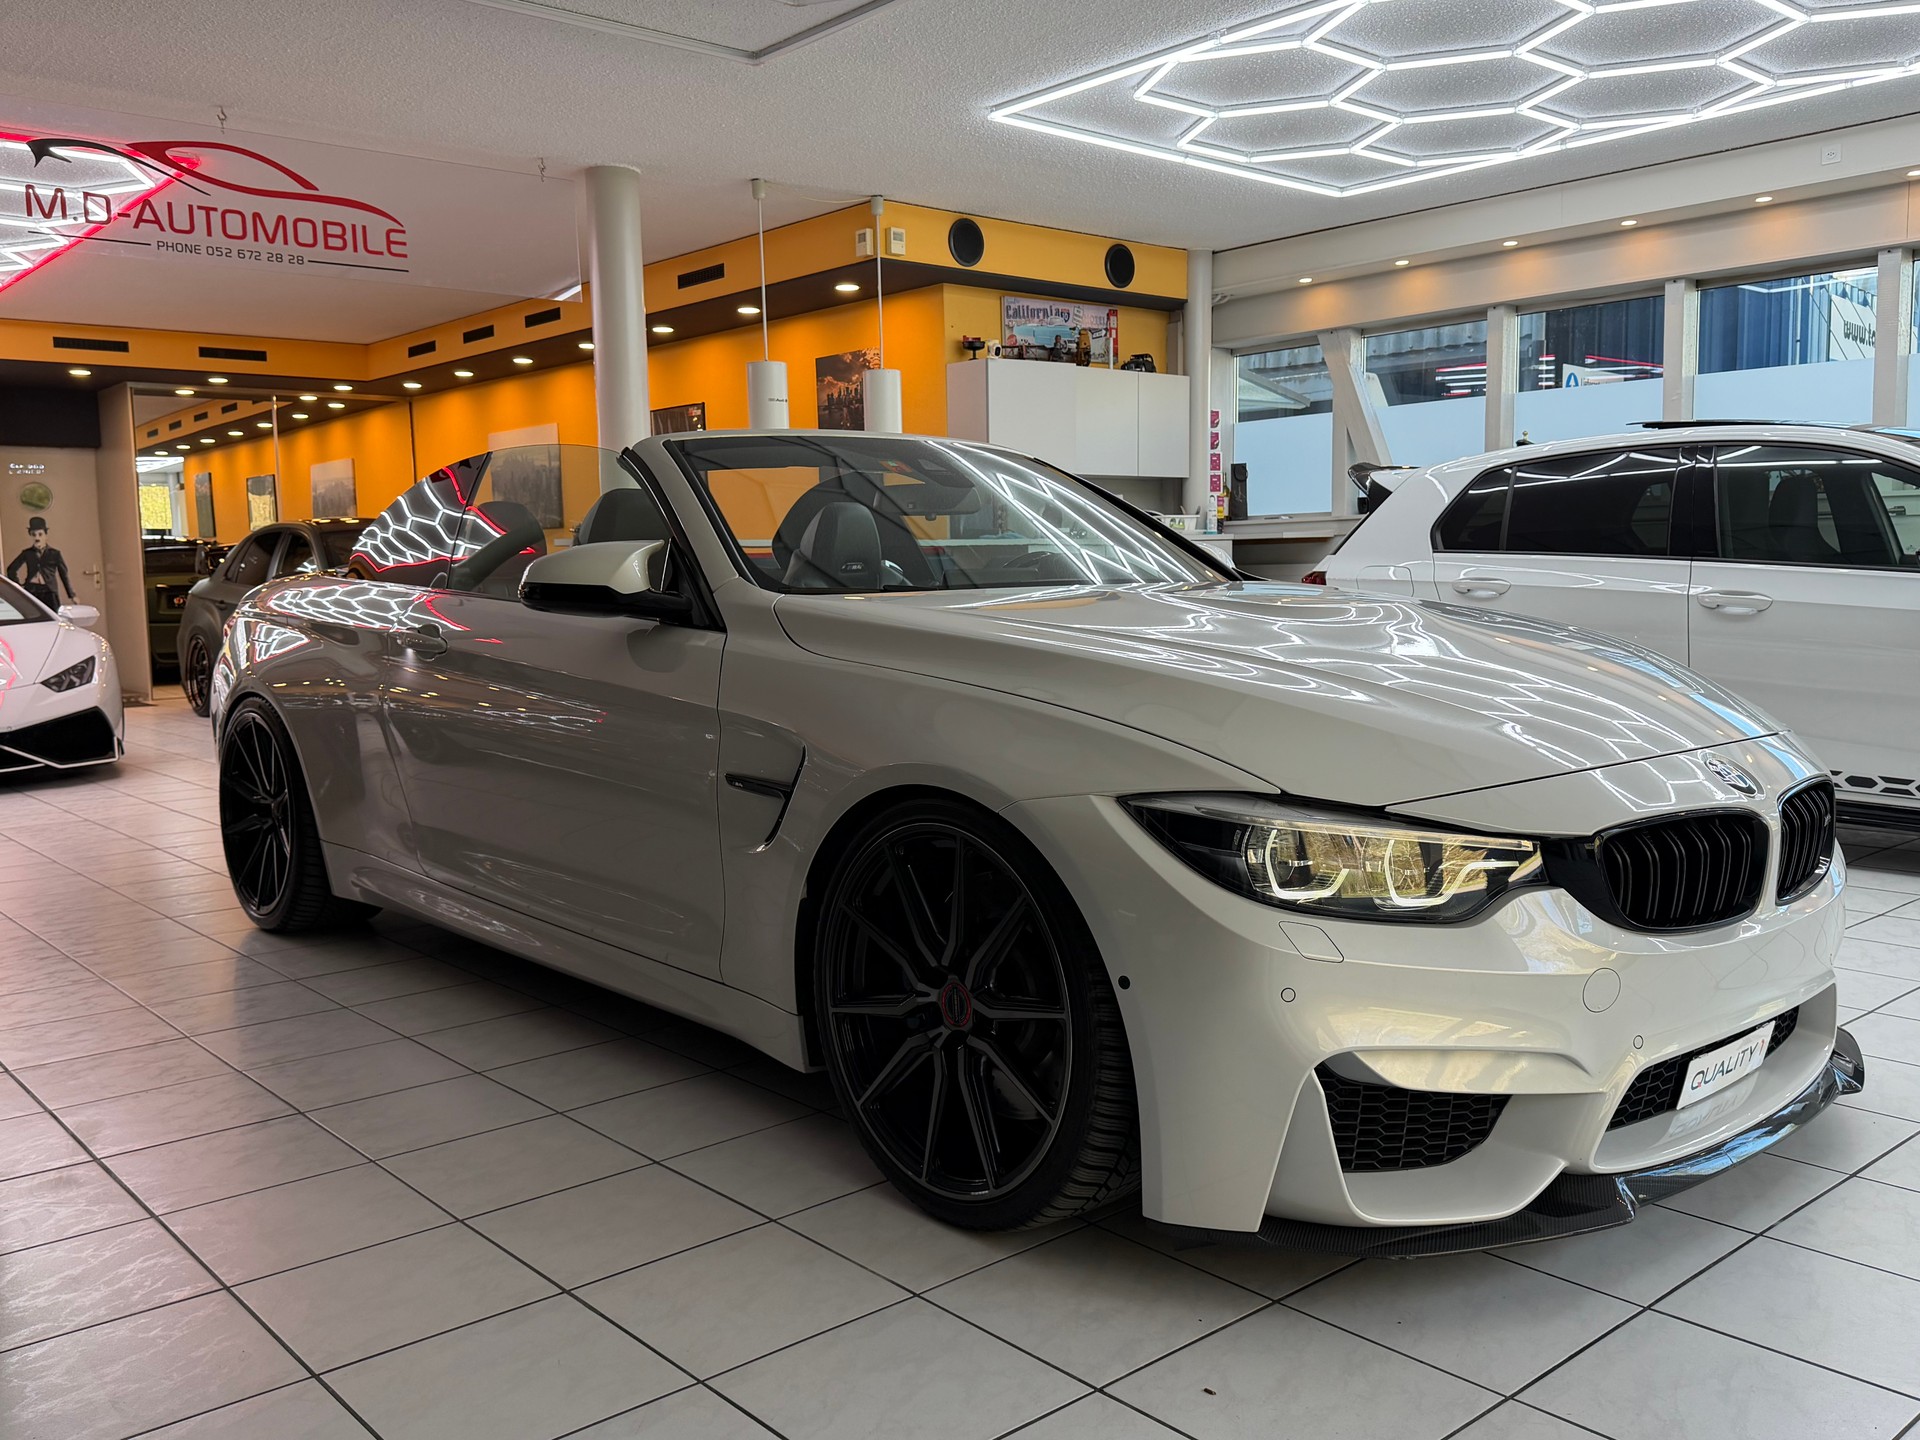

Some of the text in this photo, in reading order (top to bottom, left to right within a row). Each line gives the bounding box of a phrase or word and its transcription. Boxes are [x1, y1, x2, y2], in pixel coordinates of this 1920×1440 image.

[25, 184, 408, 259] M.D-AUTOMOBILE
[156, 240, 305, 266] PHONE 052 672 28 28
[1005, 304, 1060, 319] California
[1690, 1041, 1759, 1091] QUALITY
